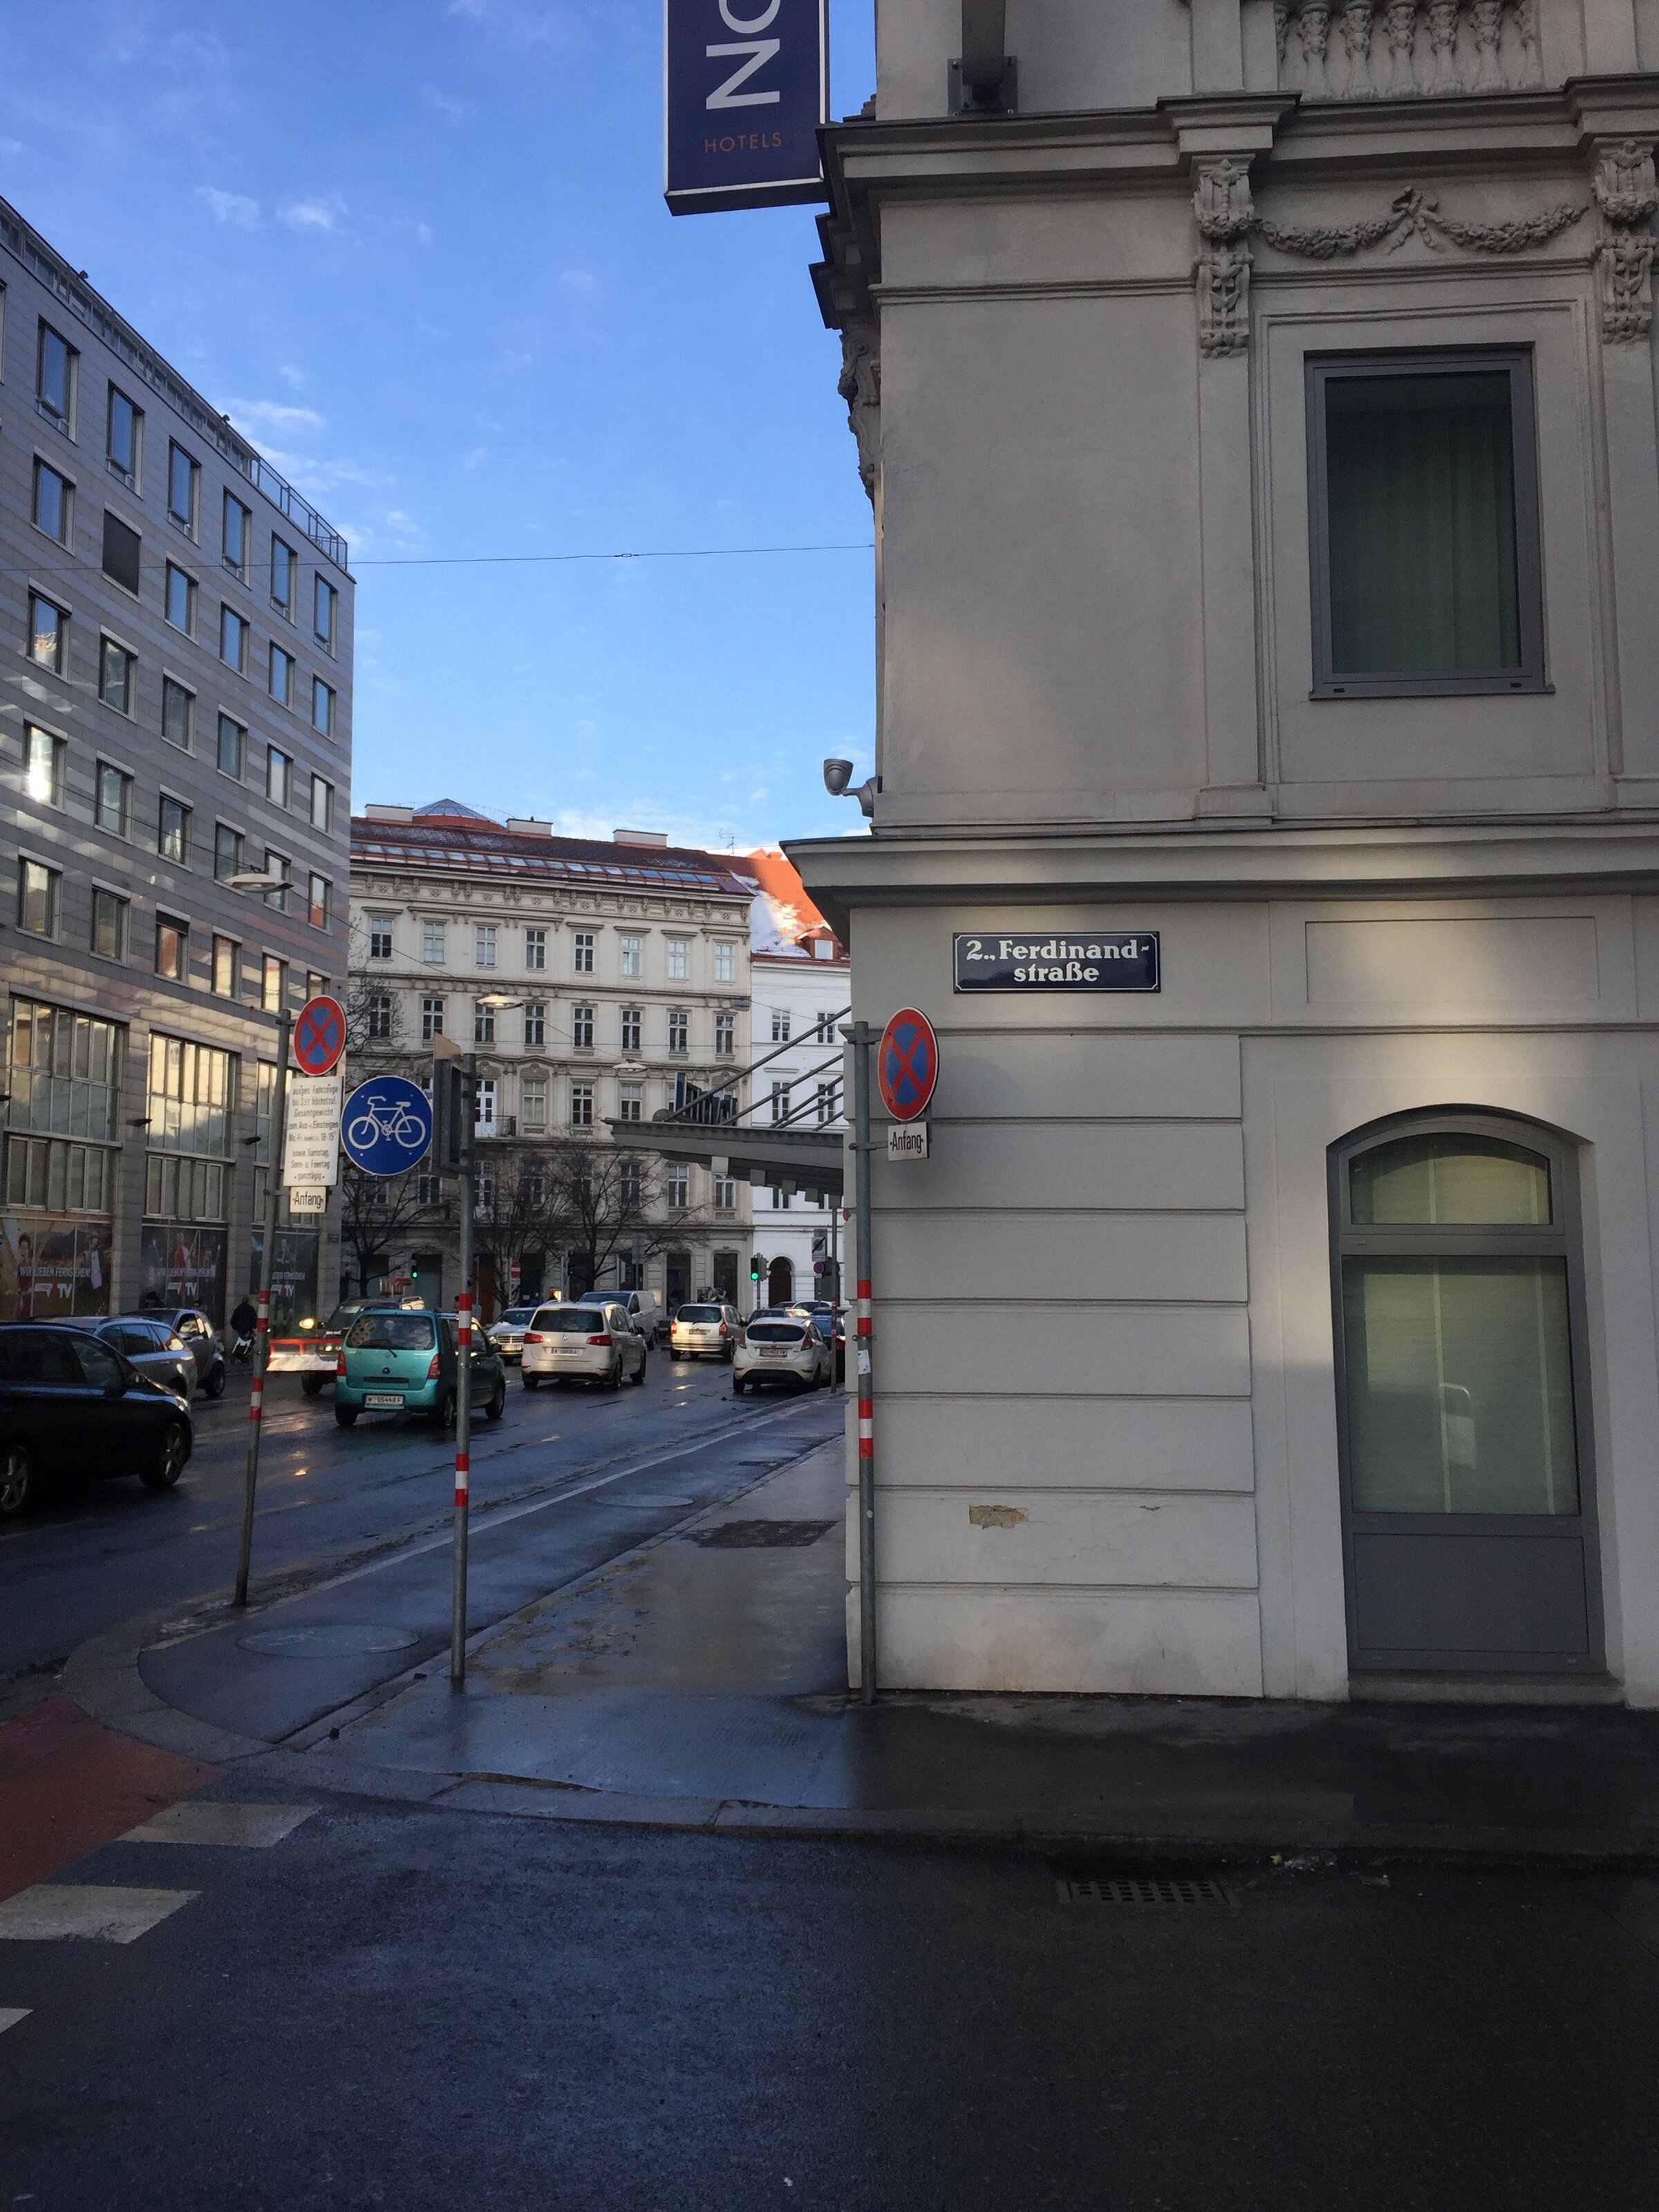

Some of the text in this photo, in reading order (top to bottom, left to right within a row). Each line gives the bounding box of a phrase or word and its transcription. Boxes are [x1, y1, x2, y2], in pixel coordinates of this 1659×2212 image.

[704, 131, 782, 153] HOTELS
[999, 939, 1150, 960] Ferdinand-
[1013, 961, 1099, 982] straße
[892, 1130, 921, 1154] Anfang
[294, 1191, 321, 1209] Anfang
